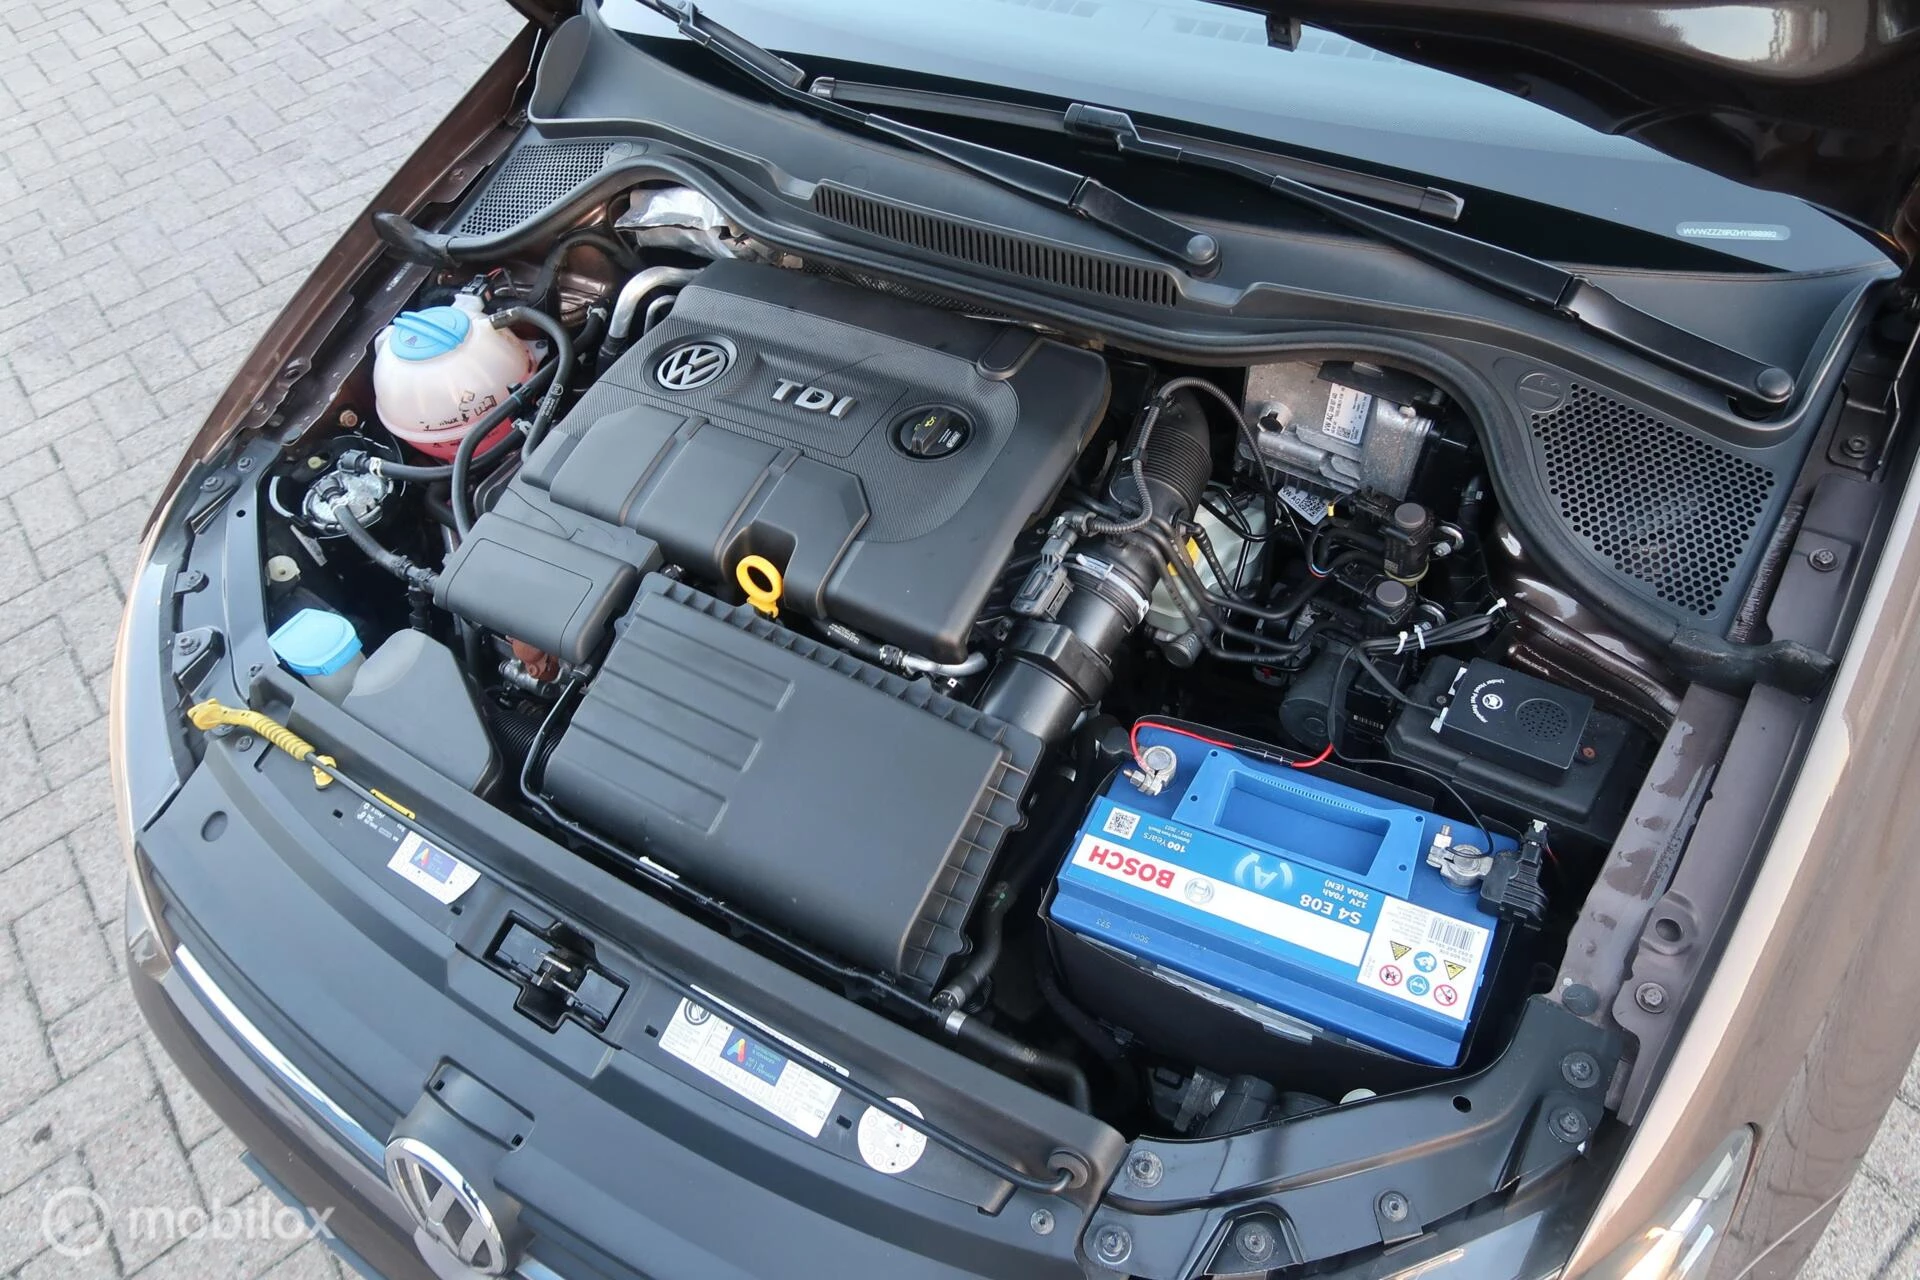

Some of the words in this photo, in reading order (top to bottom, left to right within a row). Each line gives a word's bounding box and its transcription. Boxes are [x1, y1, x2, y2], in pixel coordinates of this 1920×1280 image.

[772, 377, 856, 419] TDI
[1143, 832, 1167, 846] Years
[1167, 841, 1186, 853] 100
[1088, 845, 1176, 889] BOSCH
[1324, 879, 1345, 892] (EN)
[1322, 888, 1345, 901] 70Ah
[1347, 887, 1369, 901] 760A
[1300, 894, 1334, 916] E08
[1349, 898, 1368, 909] 12V
[1338, 906, 1362, 925] S4
